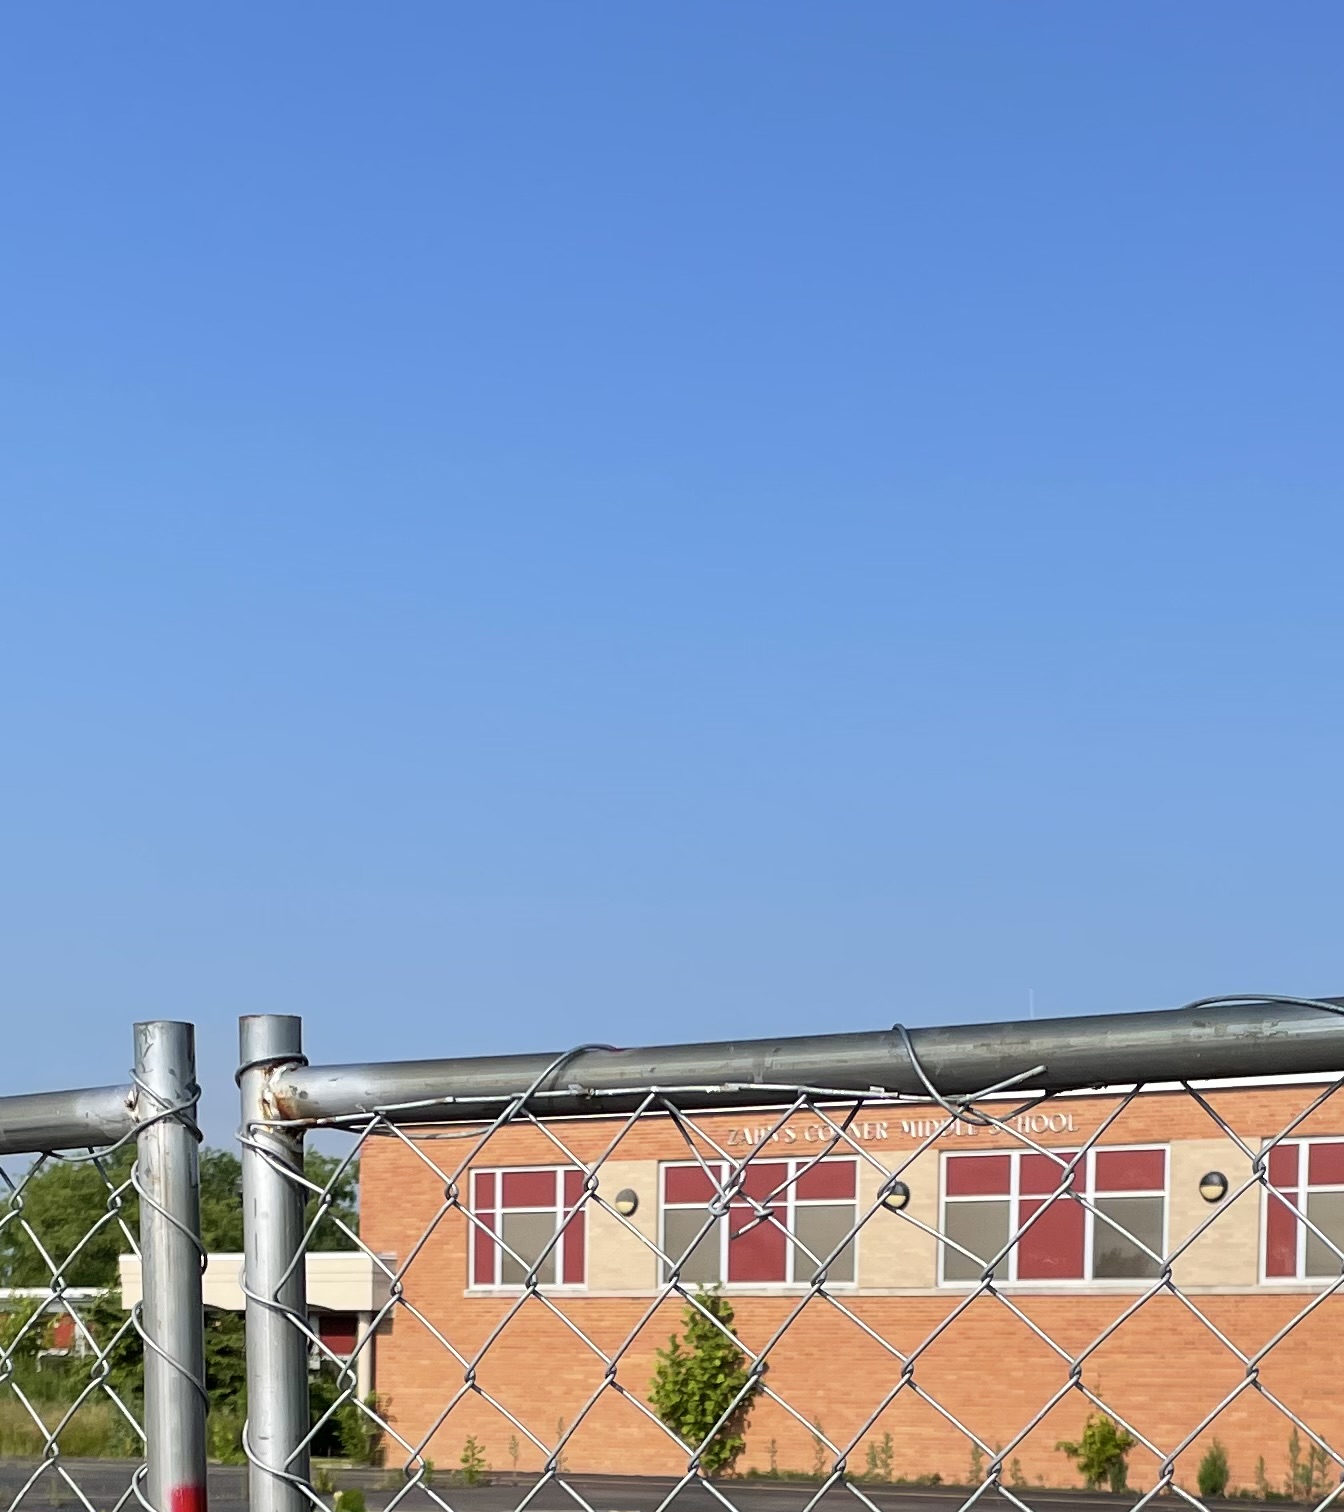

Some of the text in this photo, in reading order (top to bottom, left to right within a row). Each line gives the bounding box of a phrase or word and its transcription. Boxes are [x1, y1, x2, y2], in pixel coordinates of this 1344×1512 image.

[727, 1113, 1080, 1145] ZAHNS CONER MIDDLE SHOOL
